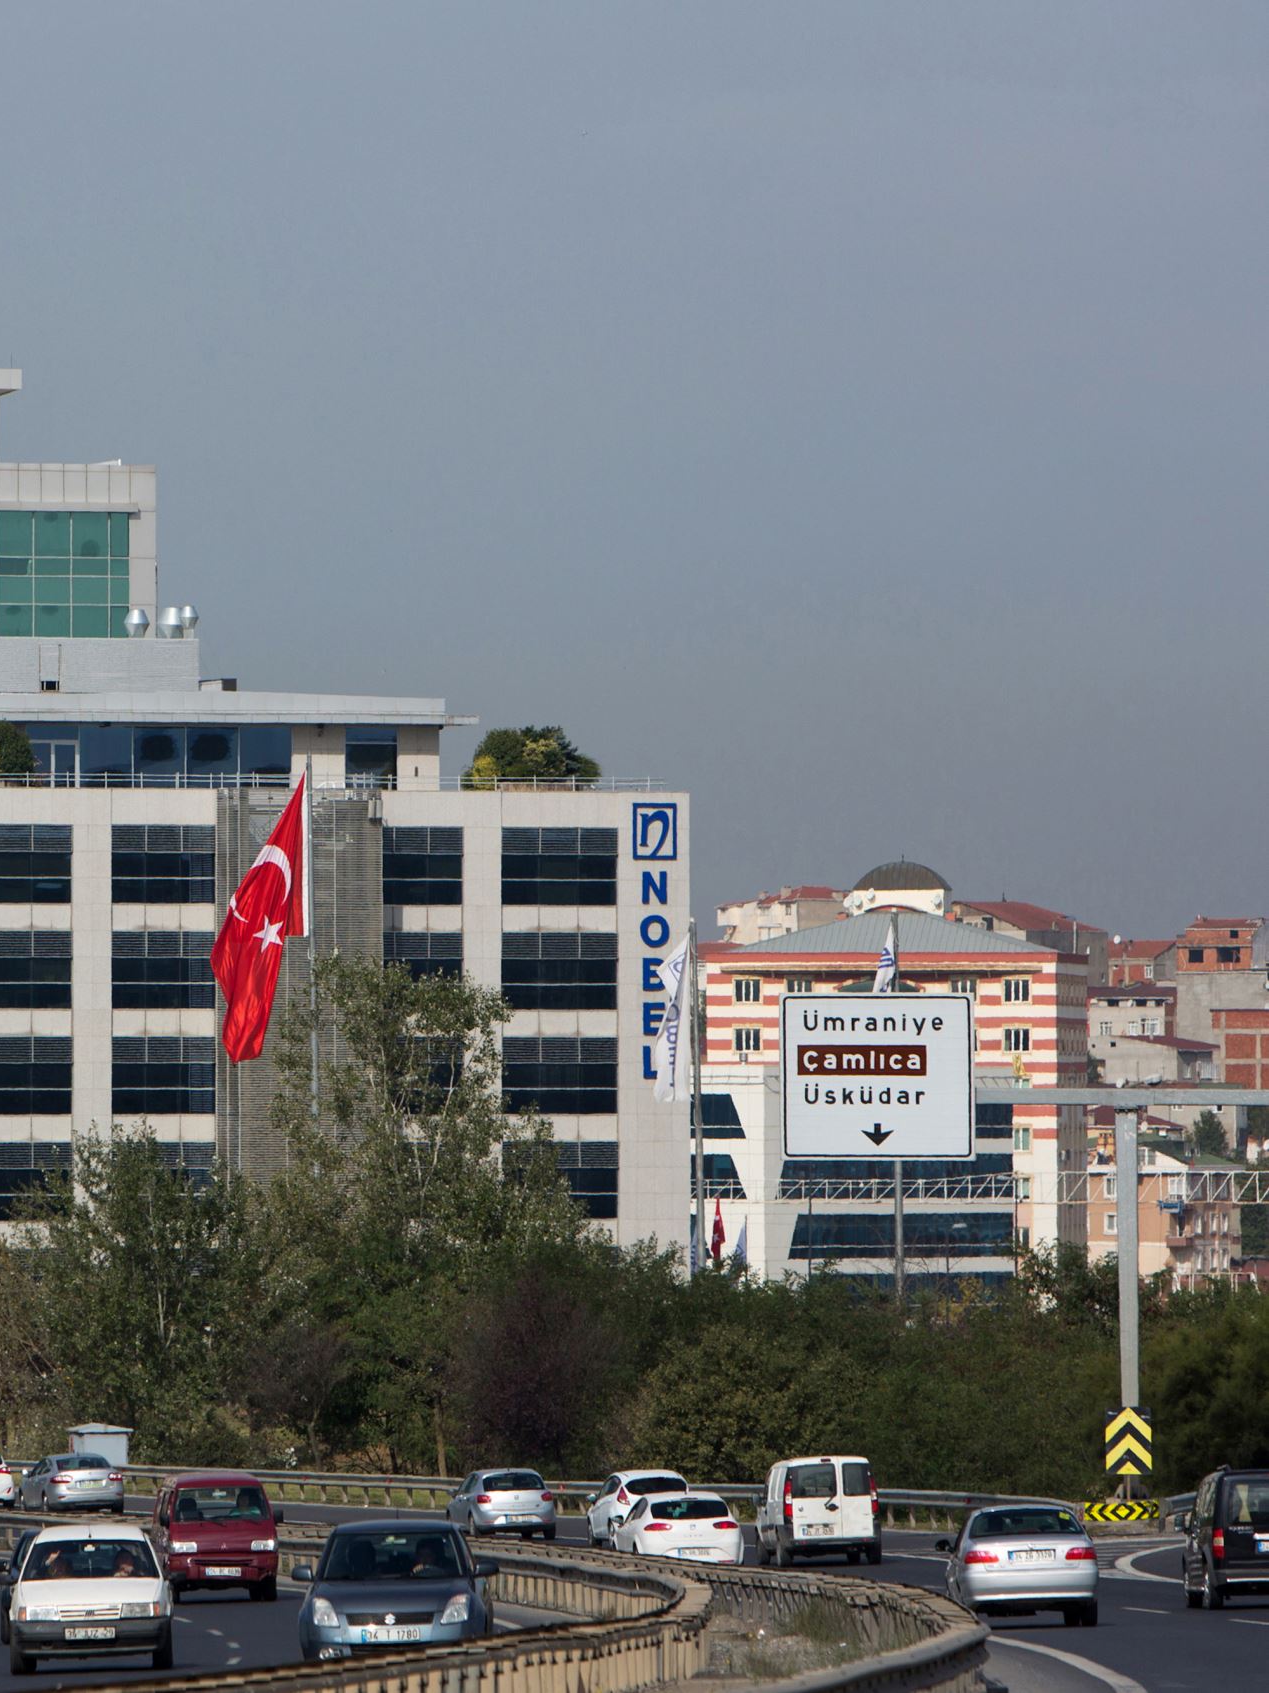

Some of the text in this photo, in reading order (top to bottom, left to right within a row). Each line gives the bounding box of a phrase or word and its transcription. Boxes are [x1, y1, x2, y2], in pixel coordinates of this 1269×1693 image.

[639, 870, 670, 1080] NOBEL
[803, 1010, 944, 1036] Ümraniye
[803, 1050, 921, 1072] Çamlıca
[804, 1083, 925, 1105] Üsküdar
